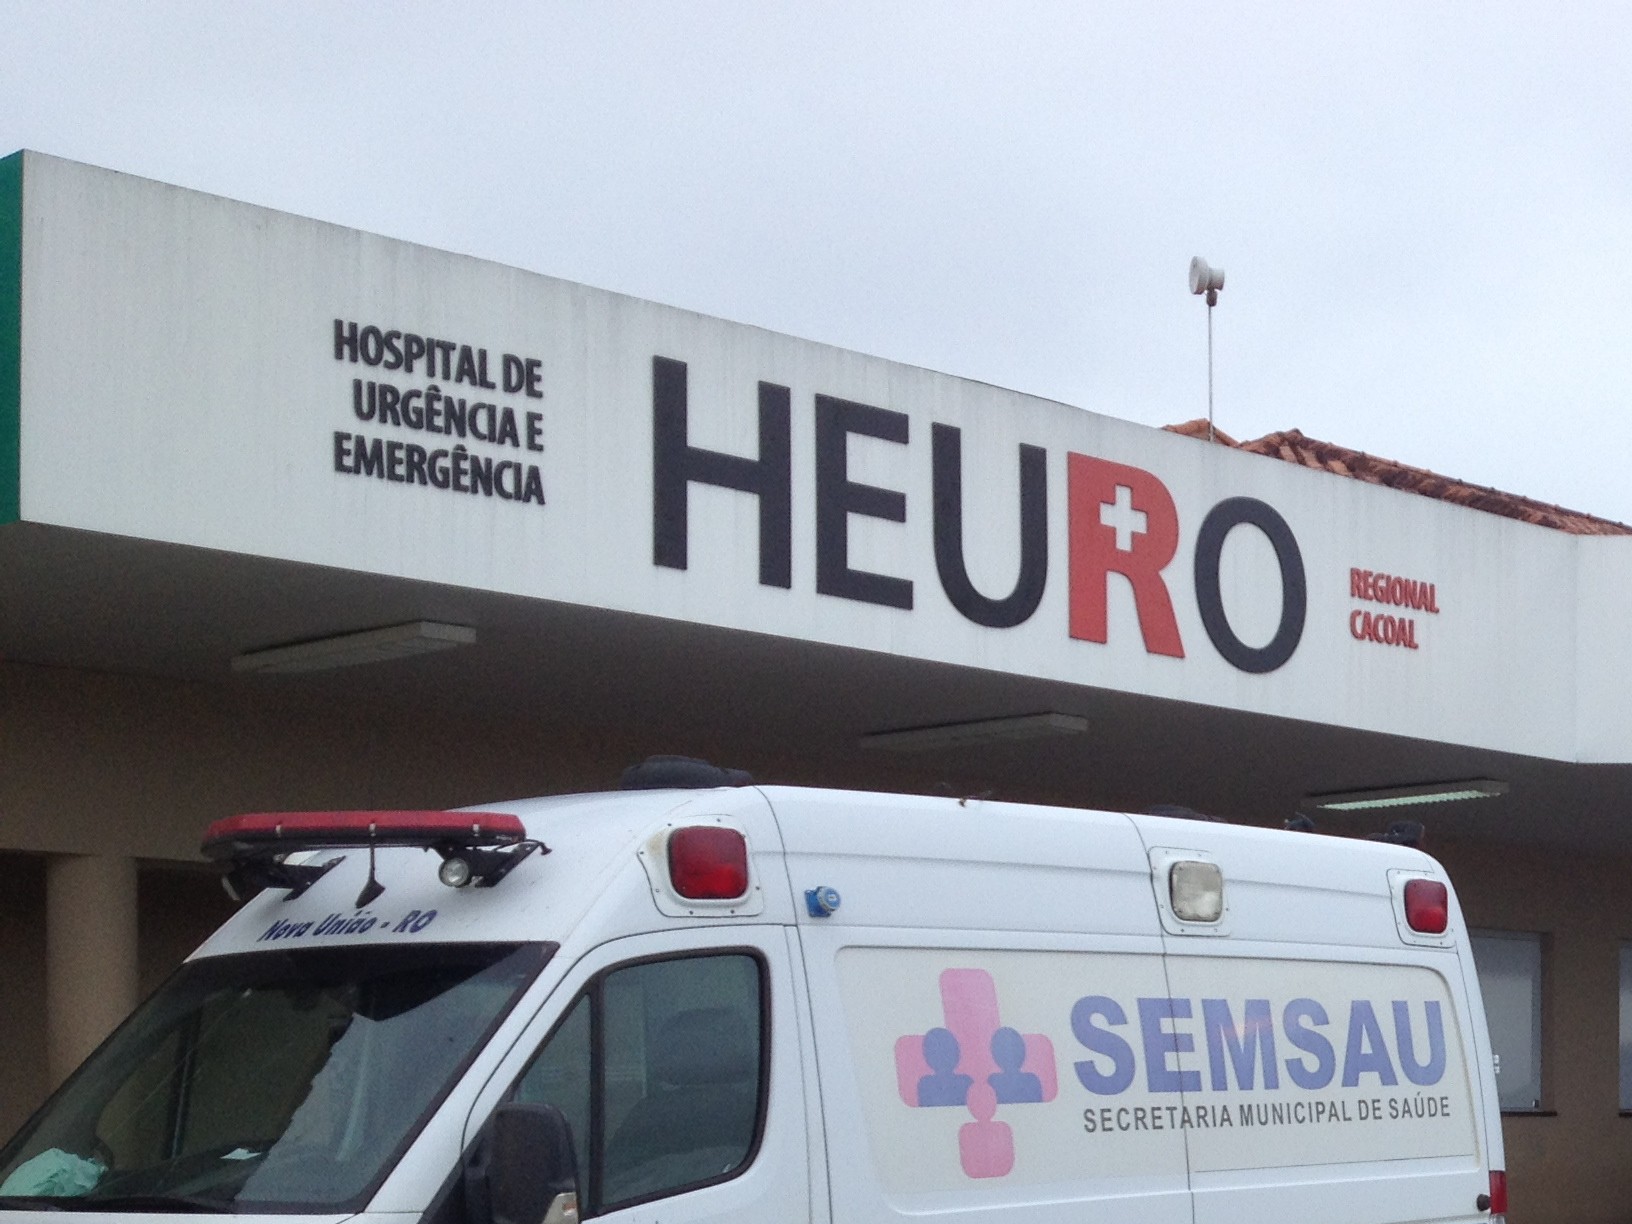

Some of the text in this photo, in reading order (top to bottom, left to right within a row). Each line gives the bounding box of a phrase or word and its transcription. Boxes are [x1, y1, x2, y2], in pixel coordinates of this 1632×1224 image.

[334, 319, 543, 399] HOSPITAL DE
[353, 378, 543, 452] URGÊNCIA E
[334, 431, 546, 505] EMERGÊNCIA
[653, 355, 1307, 674] HEURO
[1350, 567, 1439, 614] REGIONAL
[1350, 609, 1419, 650] CACOAL
[256, 918, 315, 942] Nova
[313, 910, 378, 936] União
[392, 909, 438, 933] RO
[1070, 995, 1447, 1096] SEMSAU
[1083, 1091, 1451, 1133] SECRETARIA MUNICIPAL DE SAÚDE
